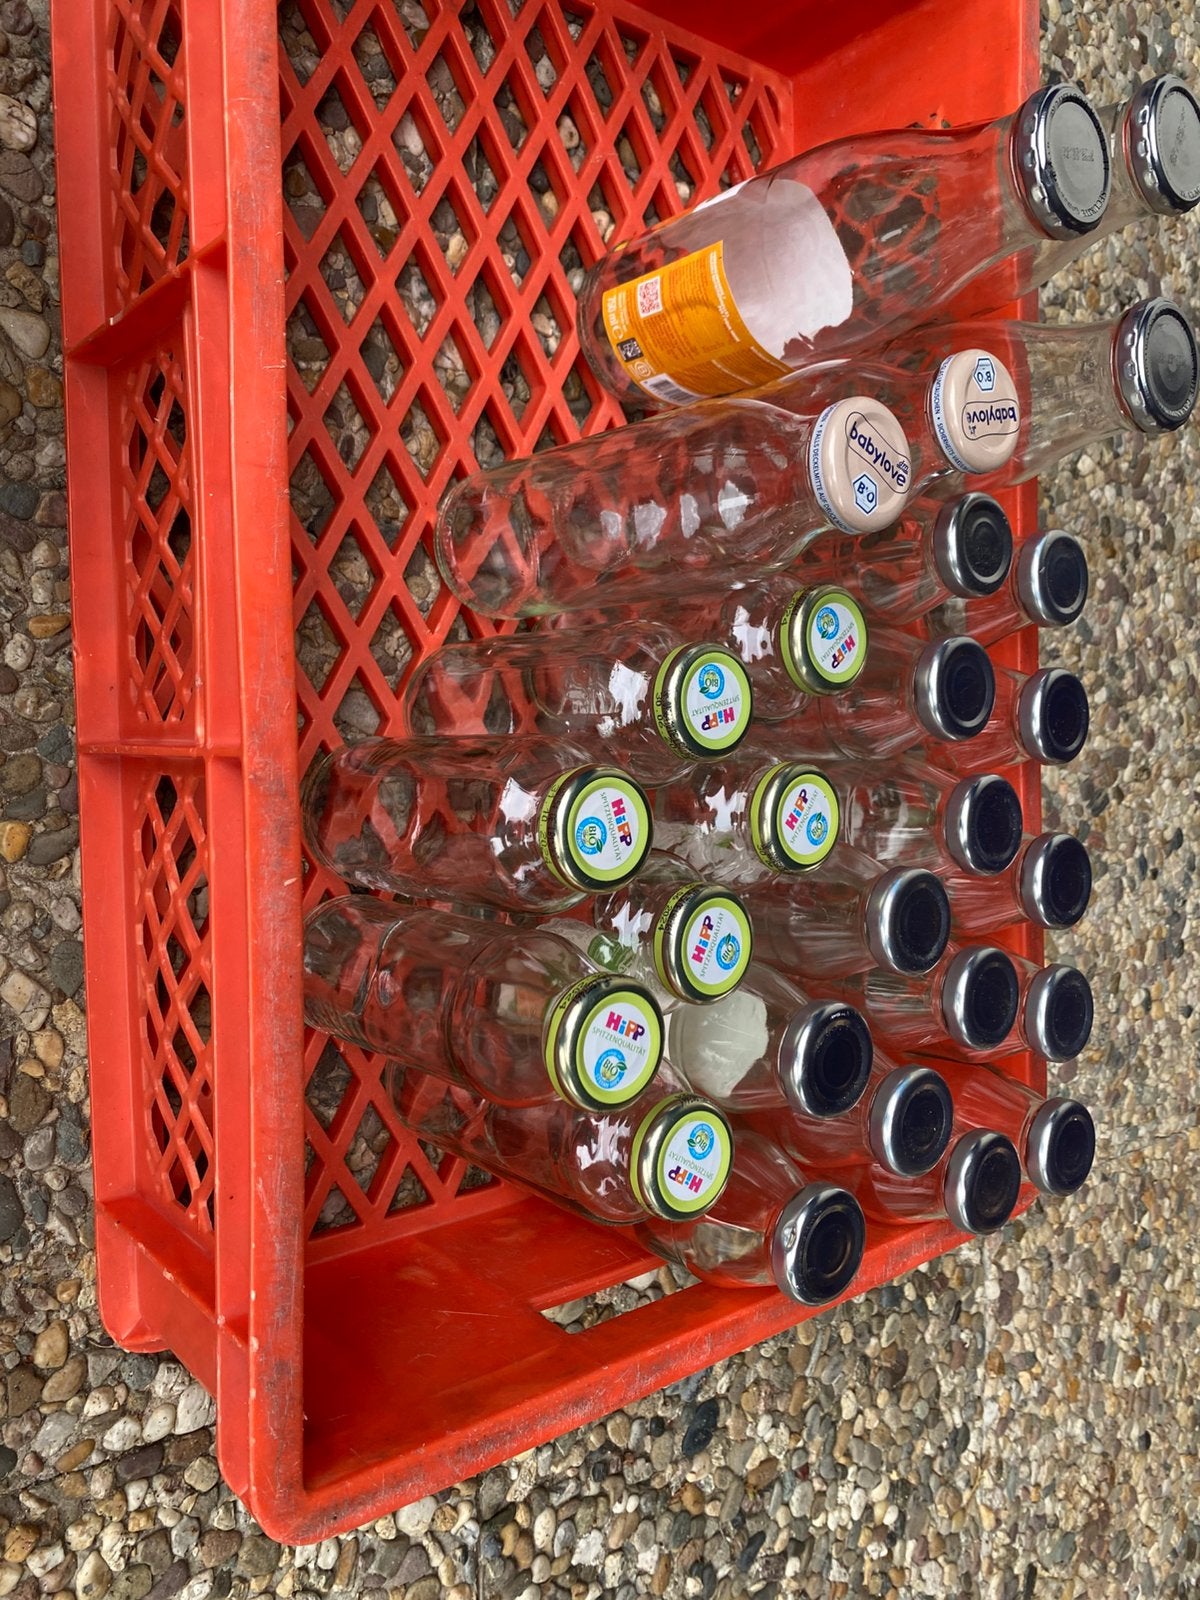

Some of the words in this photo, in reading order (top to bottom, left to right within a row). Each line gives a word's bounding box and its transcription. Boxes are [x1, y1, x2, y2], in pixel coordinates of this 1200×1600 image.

[966, 405, 1017, 425] babylove
[849, 421, 906, 487] babylove
[602, 1059, 619, 1077] BIO
